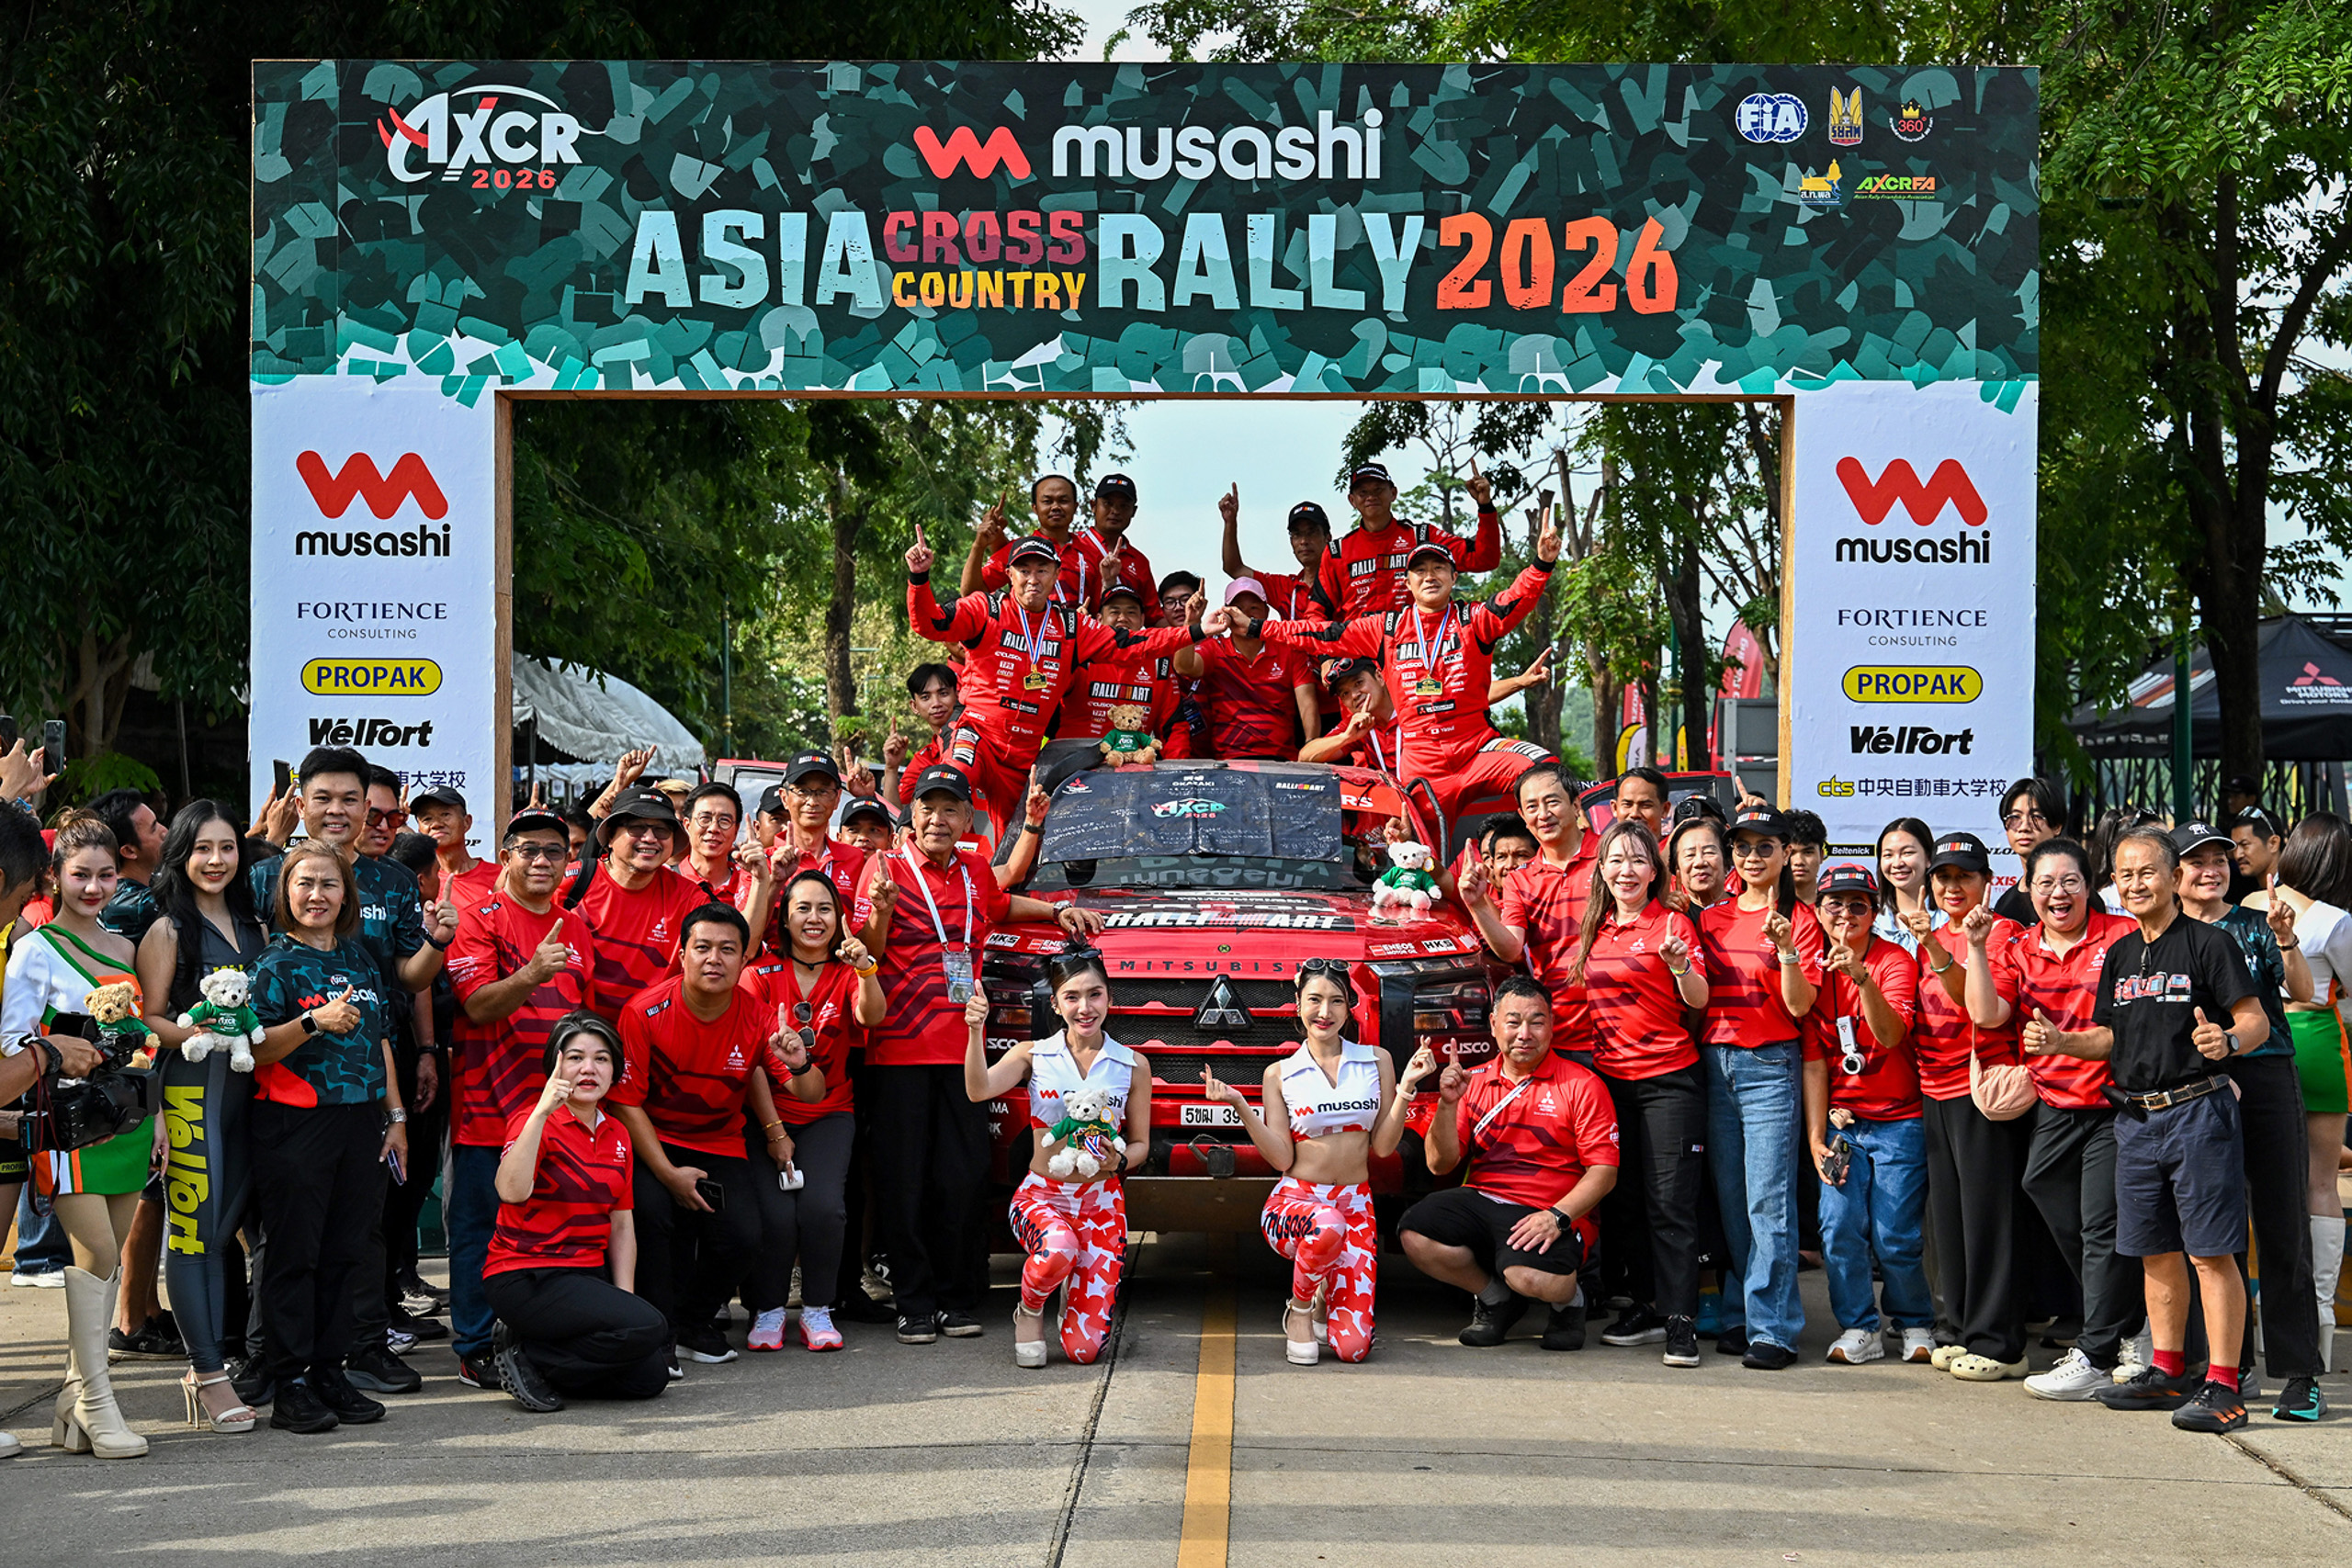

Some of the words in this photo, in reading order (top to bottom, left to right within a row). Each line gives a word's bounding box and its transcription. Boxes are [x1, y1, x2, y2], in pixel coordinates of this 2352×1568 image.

[381, 89, 588, 182] AXCR
[1052, 107, 1383, 180] musashi
[471, 170, 555, 189] 2026
[1856, 174, 1935, 193] AXCRFA
[883, 210, 1087, 266] CROSS
[625, 209, 885, 310] ASIA
[1098, 211, 1425, 312] RALLY
[1436, 212, 1679, 315] 2026
[891, 270, 1086, 310] COUNTRY
[295, 523, 451, 558] musashi
[1836, 530, 1991, 564] musashi
[297, 602, 447, 623] FORTIENCE
[1838, 609, 1987, 629] FORTIENCE
[327, 628, 417, 639] CONSULTING
[1868, 636, 1957, 647] CONSULTING
[316, 666, 426, 689] PROPAK
[1858, 673, 1966, 696] PROPAK
[1817, 775, 1855, 798] cts
[1858, 777, 2007, 798] 中央自動車大学校
[1831, 847, 1870, 855] Beltenick
[989, 933, 1019, 944] HKS
[1383, 942, 1416, 951] ENEOS
[1424, 938, 1453, 950] HKS
[987, 1037, 1019, 1050] SCO
